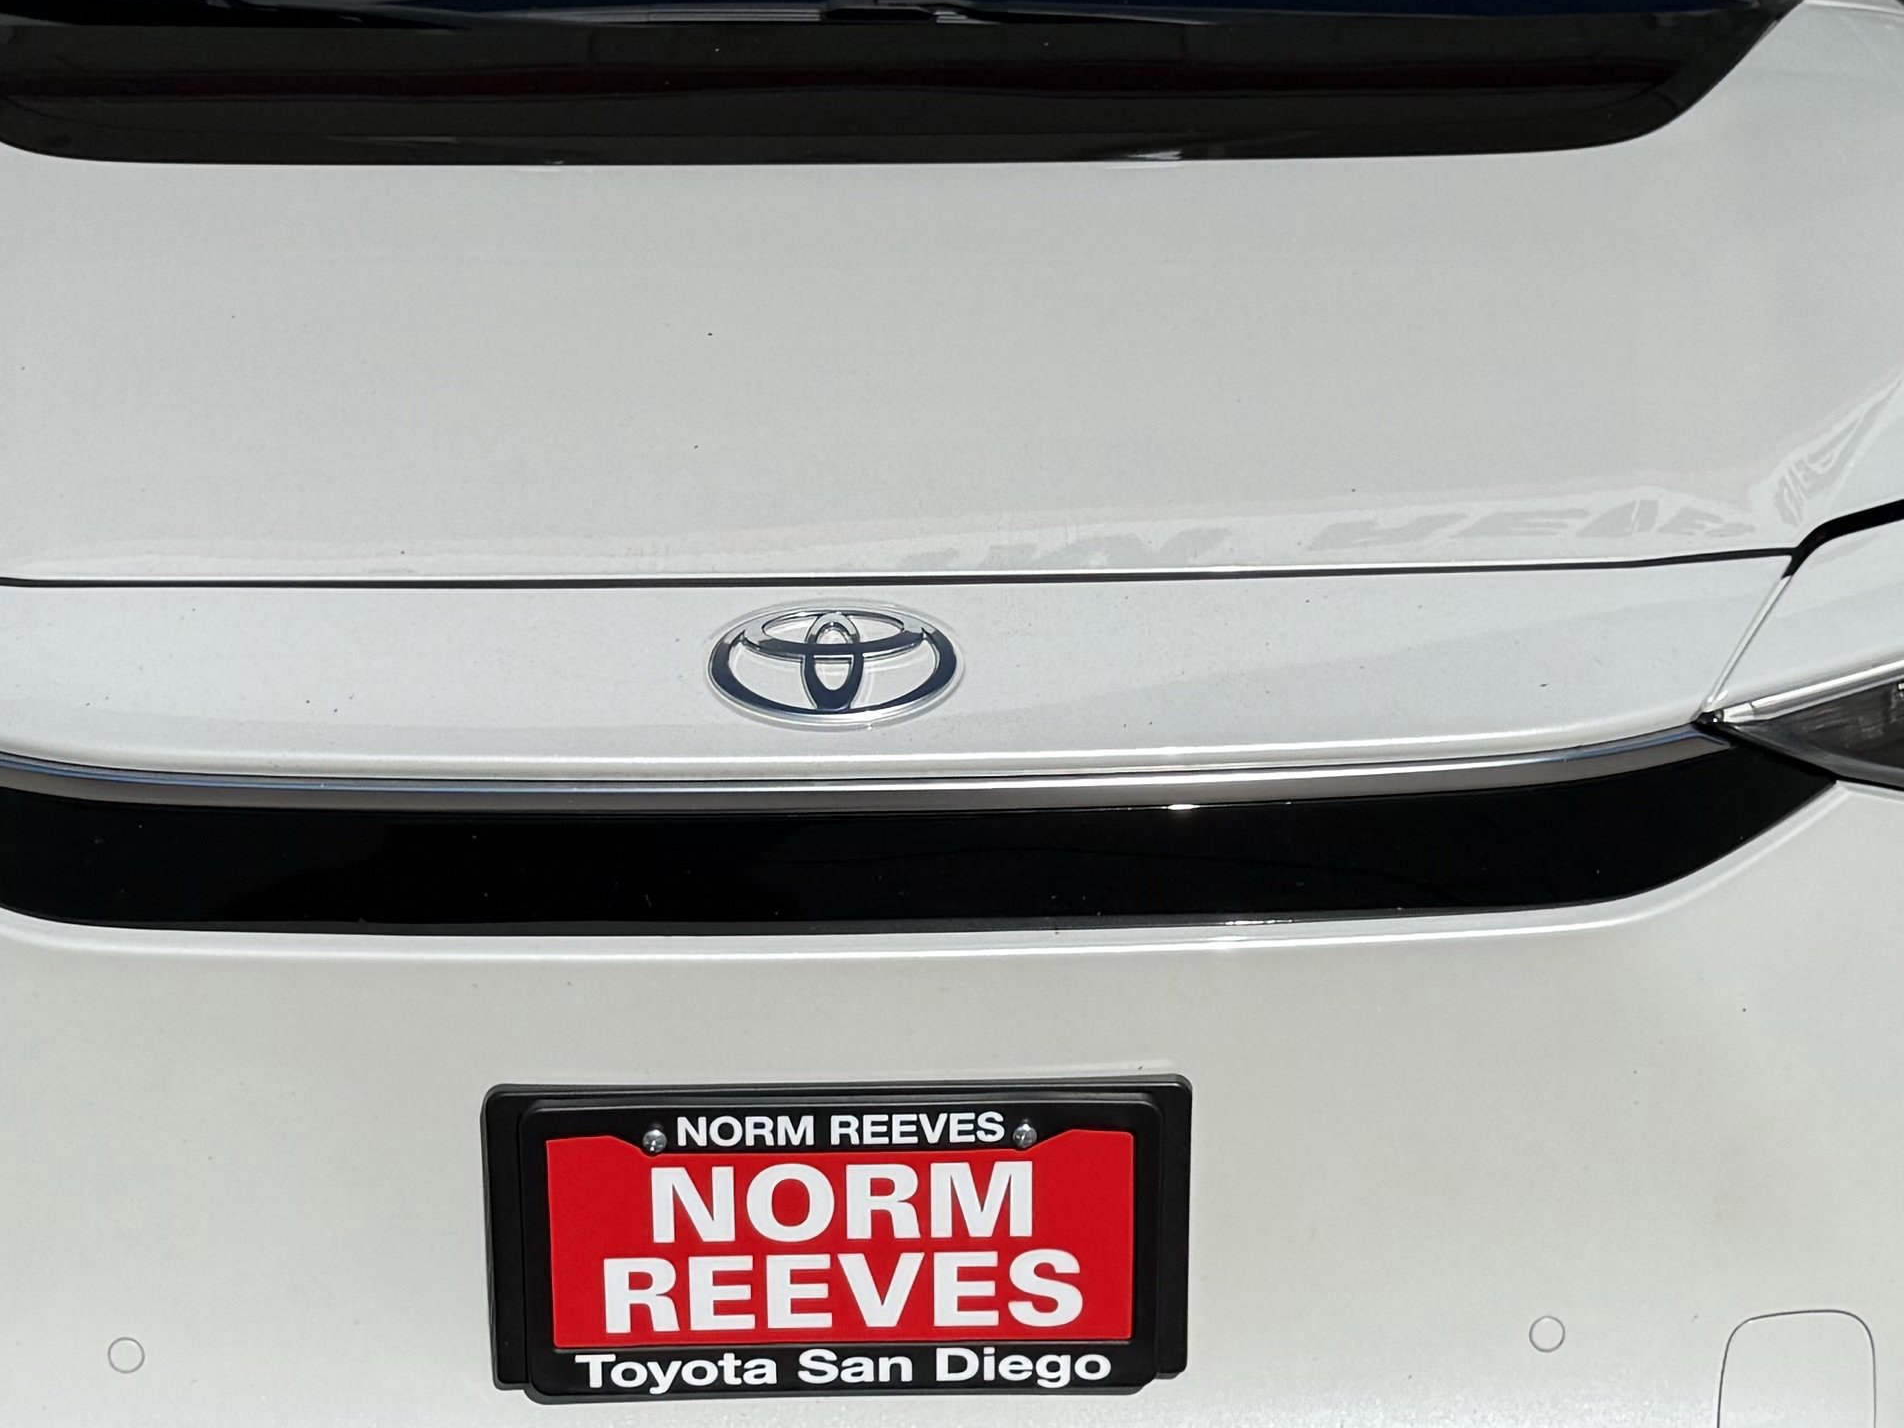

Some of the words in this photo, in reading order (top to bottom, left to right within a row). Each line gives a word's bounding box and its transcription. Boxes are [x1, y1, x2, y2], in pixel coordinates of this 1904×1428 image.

[676, 1115, 815, 1146] NORM
[829, 1111, 1006, 1144] REEVES
[649, 1160, 1034, 1244] NORM
[603, 1248, 1084, 1335] REEVES
[574, 1352, 778, 1395] Toyota
[797, 1347, 914, 1386] San
[934, 1345, 1112, 1390] Diego
